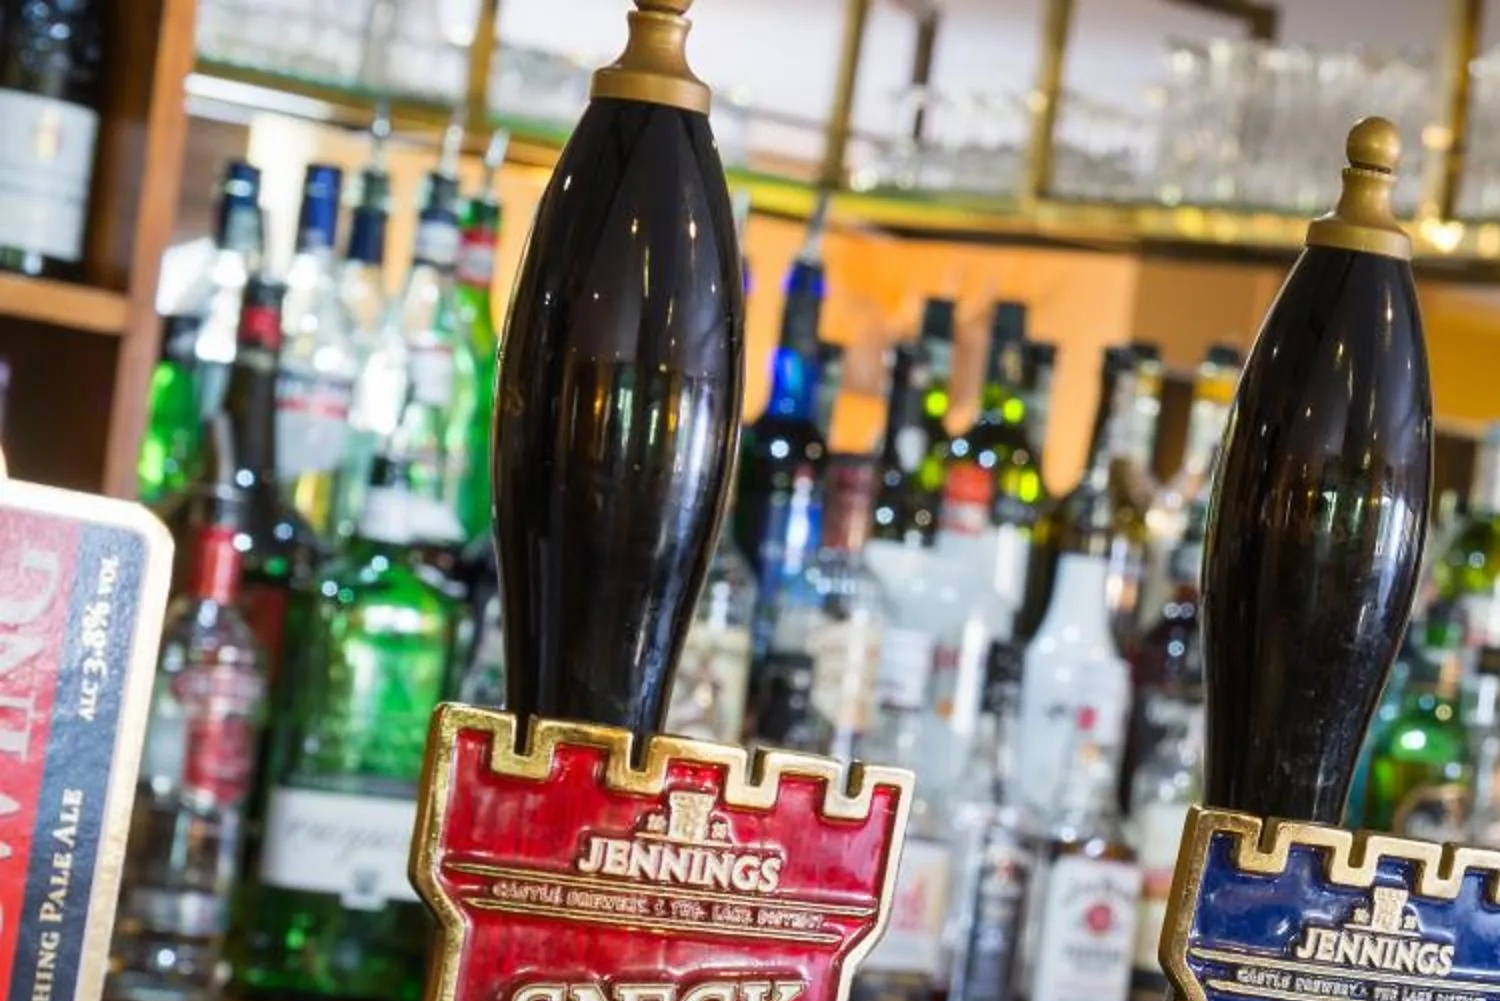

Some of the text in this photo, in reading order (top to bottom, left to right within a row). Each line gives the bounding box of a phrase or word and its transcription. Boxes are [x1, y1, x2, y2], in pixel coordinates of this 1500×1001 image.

[77, 553, 120, 722] ALC 3.8% VOL
[52, 787, 84, 849] ALE
[39, 850, 73, 923] PALE
[577, 837, 783, 893] JENNINGS
[1296, 926, 1455, 977] JENNINGS
